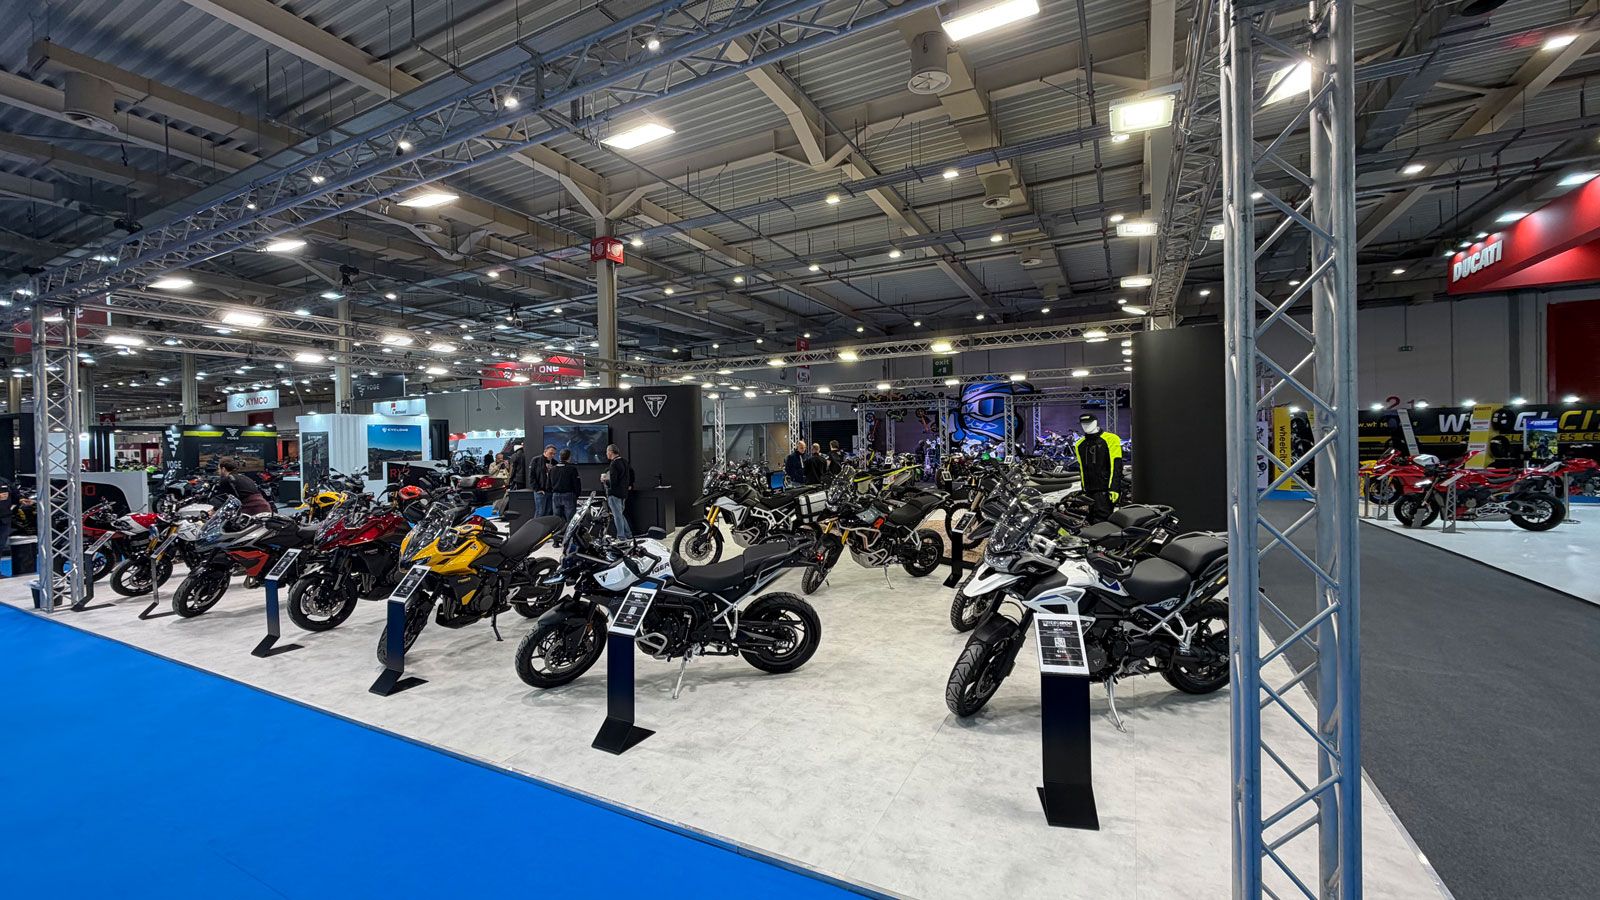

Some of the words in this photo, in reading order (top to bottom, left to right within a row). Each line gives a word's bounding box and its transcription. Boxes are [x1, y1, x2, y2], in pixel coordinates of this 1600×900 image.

[1453, 240, 1503, 282] DUCATI
[539, 365, 560, 374] ONE
[246, 397, 269, 406] KYMCO
[536, 398, 634, 424] TRIUMPH
[167, 460, 182, 469] VOGE
[651, 561, 670, 574] IGER
